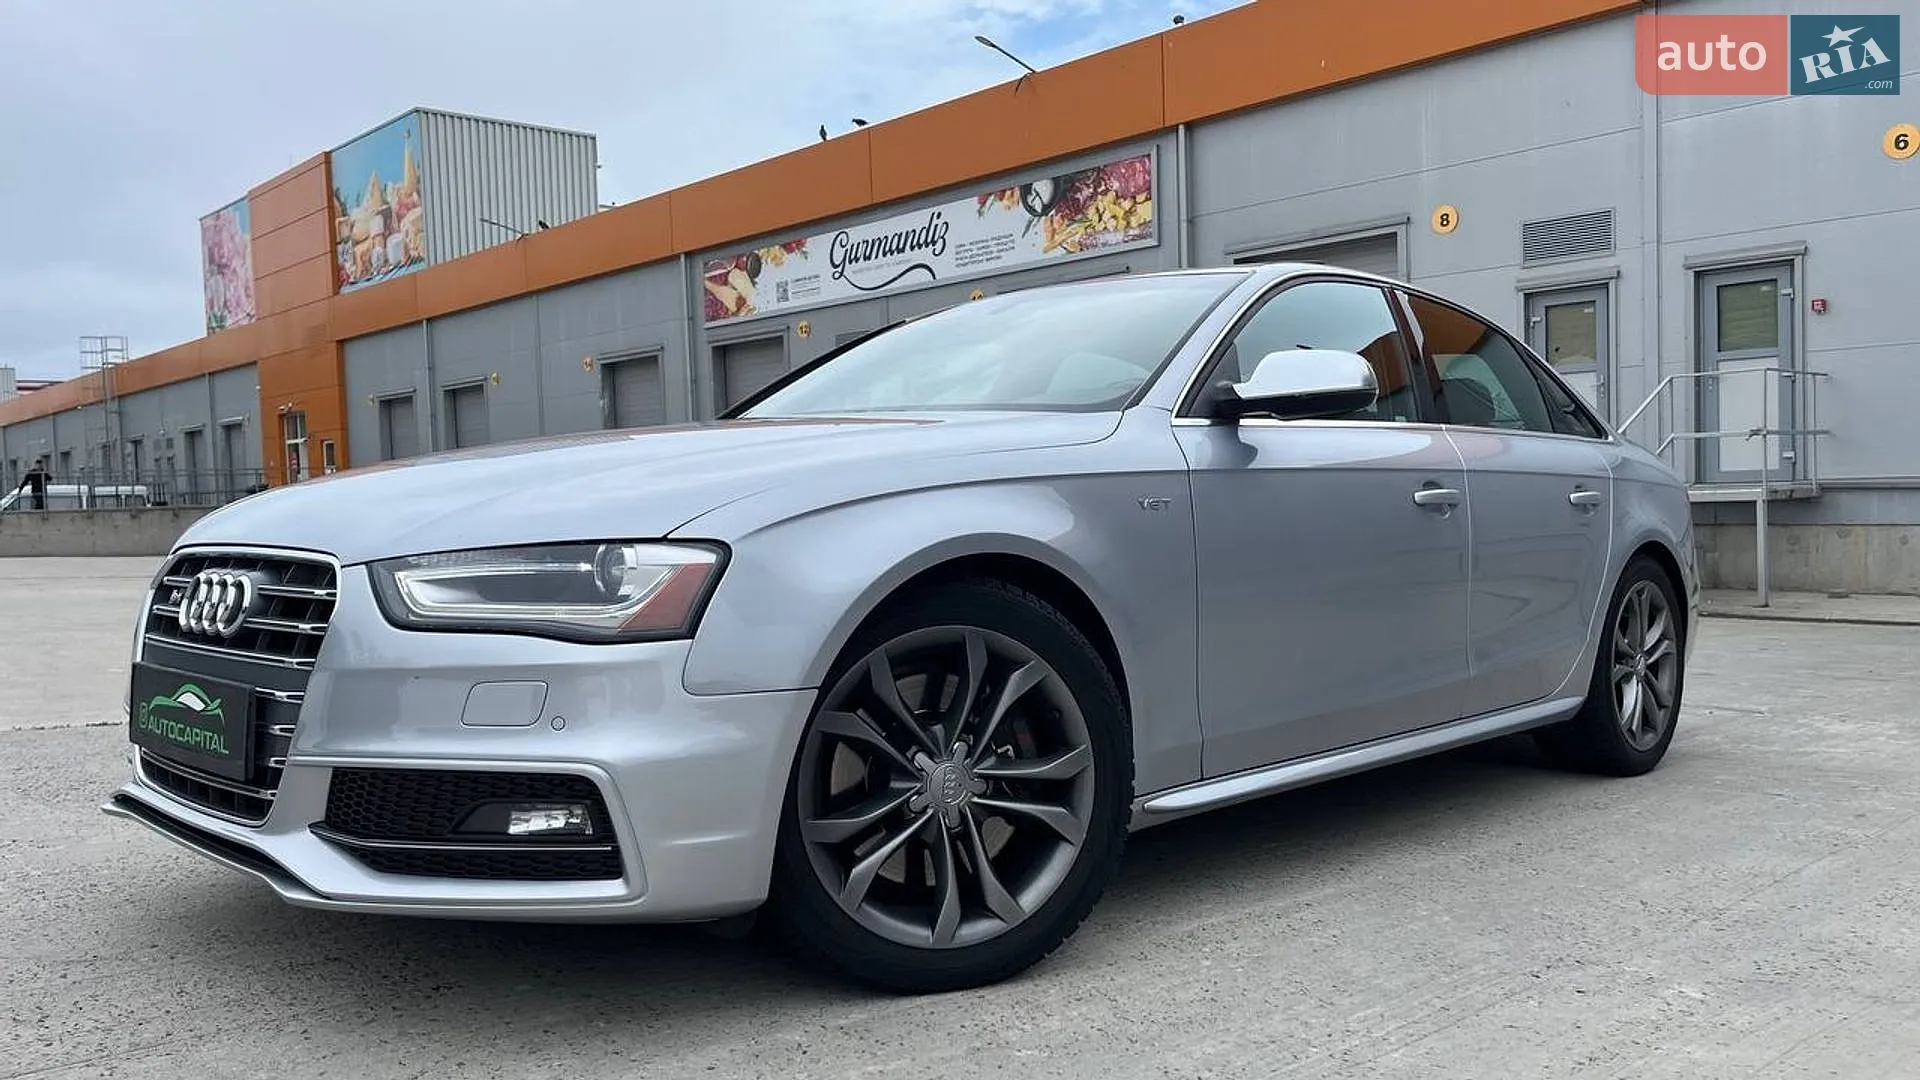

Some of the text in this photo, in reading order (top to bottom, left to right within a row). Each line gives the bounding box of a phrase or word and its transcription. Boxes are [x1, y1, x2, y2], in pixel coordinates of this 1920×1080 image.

[1894, 133, 1910, 151] 6
[1440, 212, 1451, 228] 8
[829, 211, 949, 280] Gurmandiz
[148, 715, 229, 754] AUTOCAPITAL
